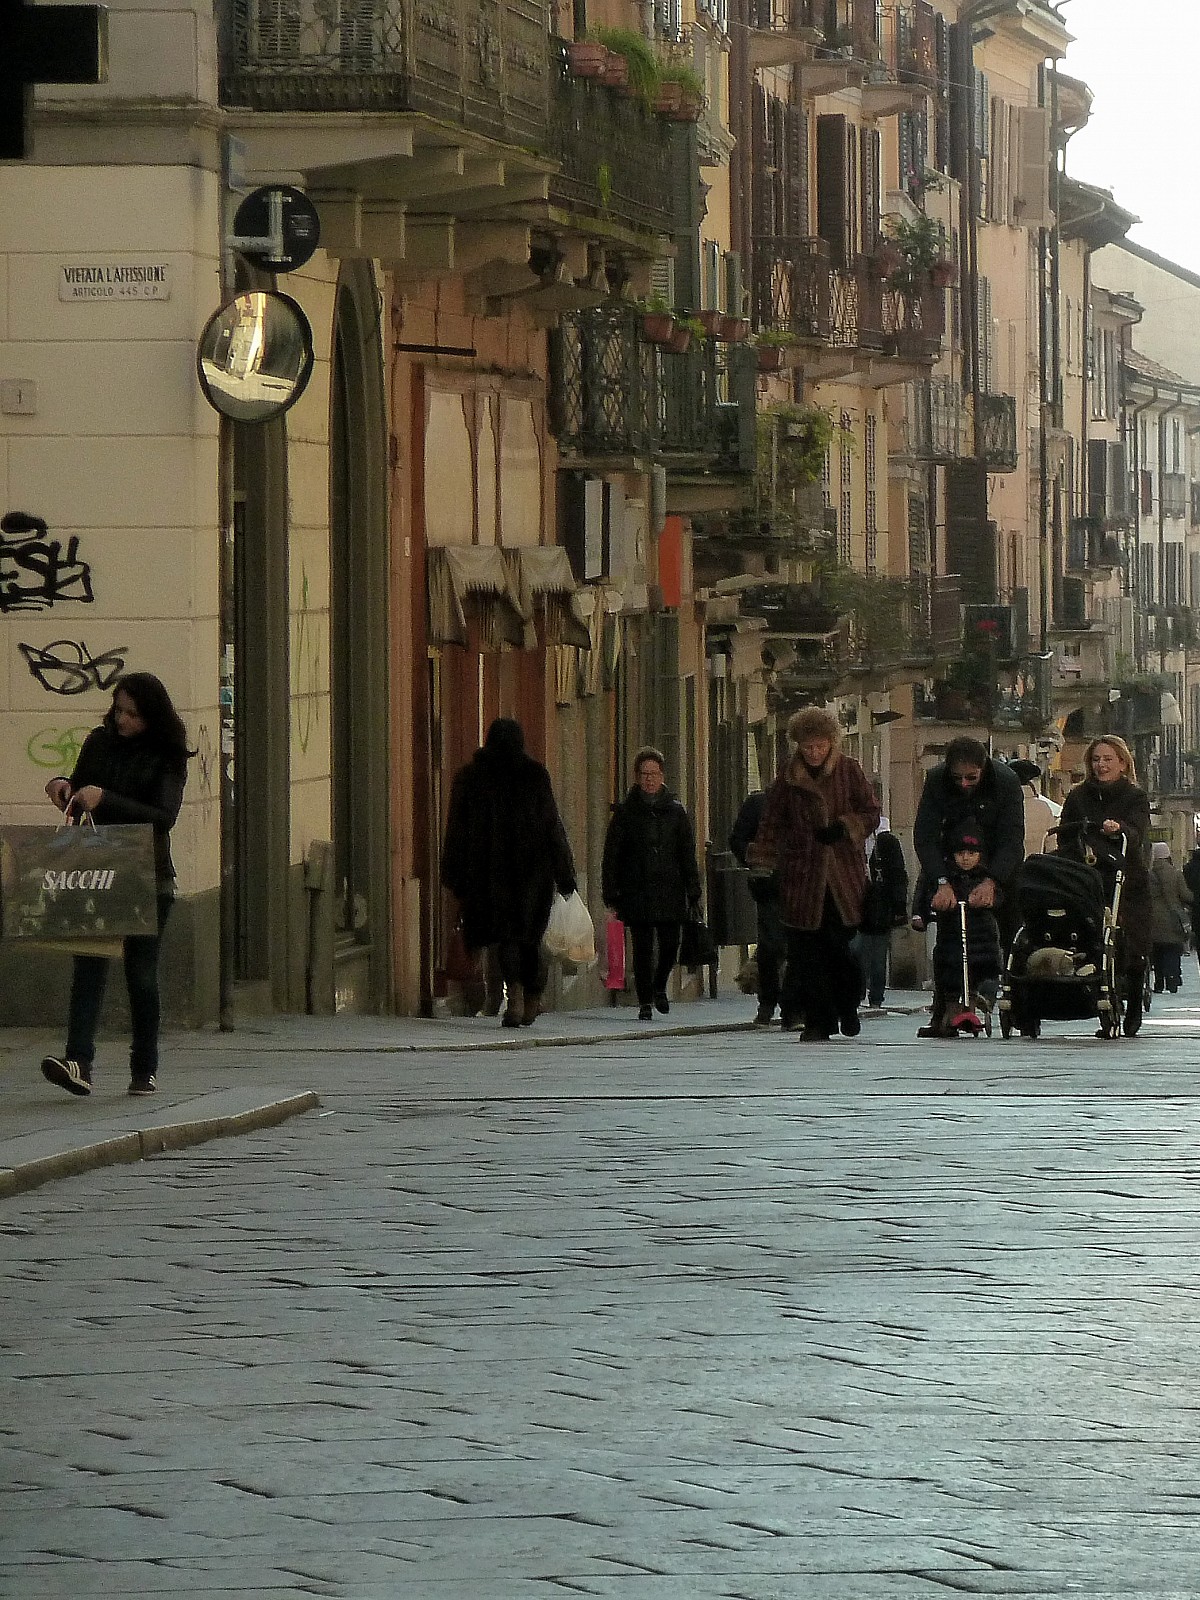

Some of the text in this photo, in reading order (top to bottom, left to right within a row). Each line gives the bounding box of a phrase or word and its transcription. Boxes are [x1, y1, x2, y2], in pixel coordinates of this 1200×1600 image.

[64, 267, 104, 283] VIETATA
[72, 287, 114, 297] ARTICOLO
[42, 869, 115, 890] SACCHI
